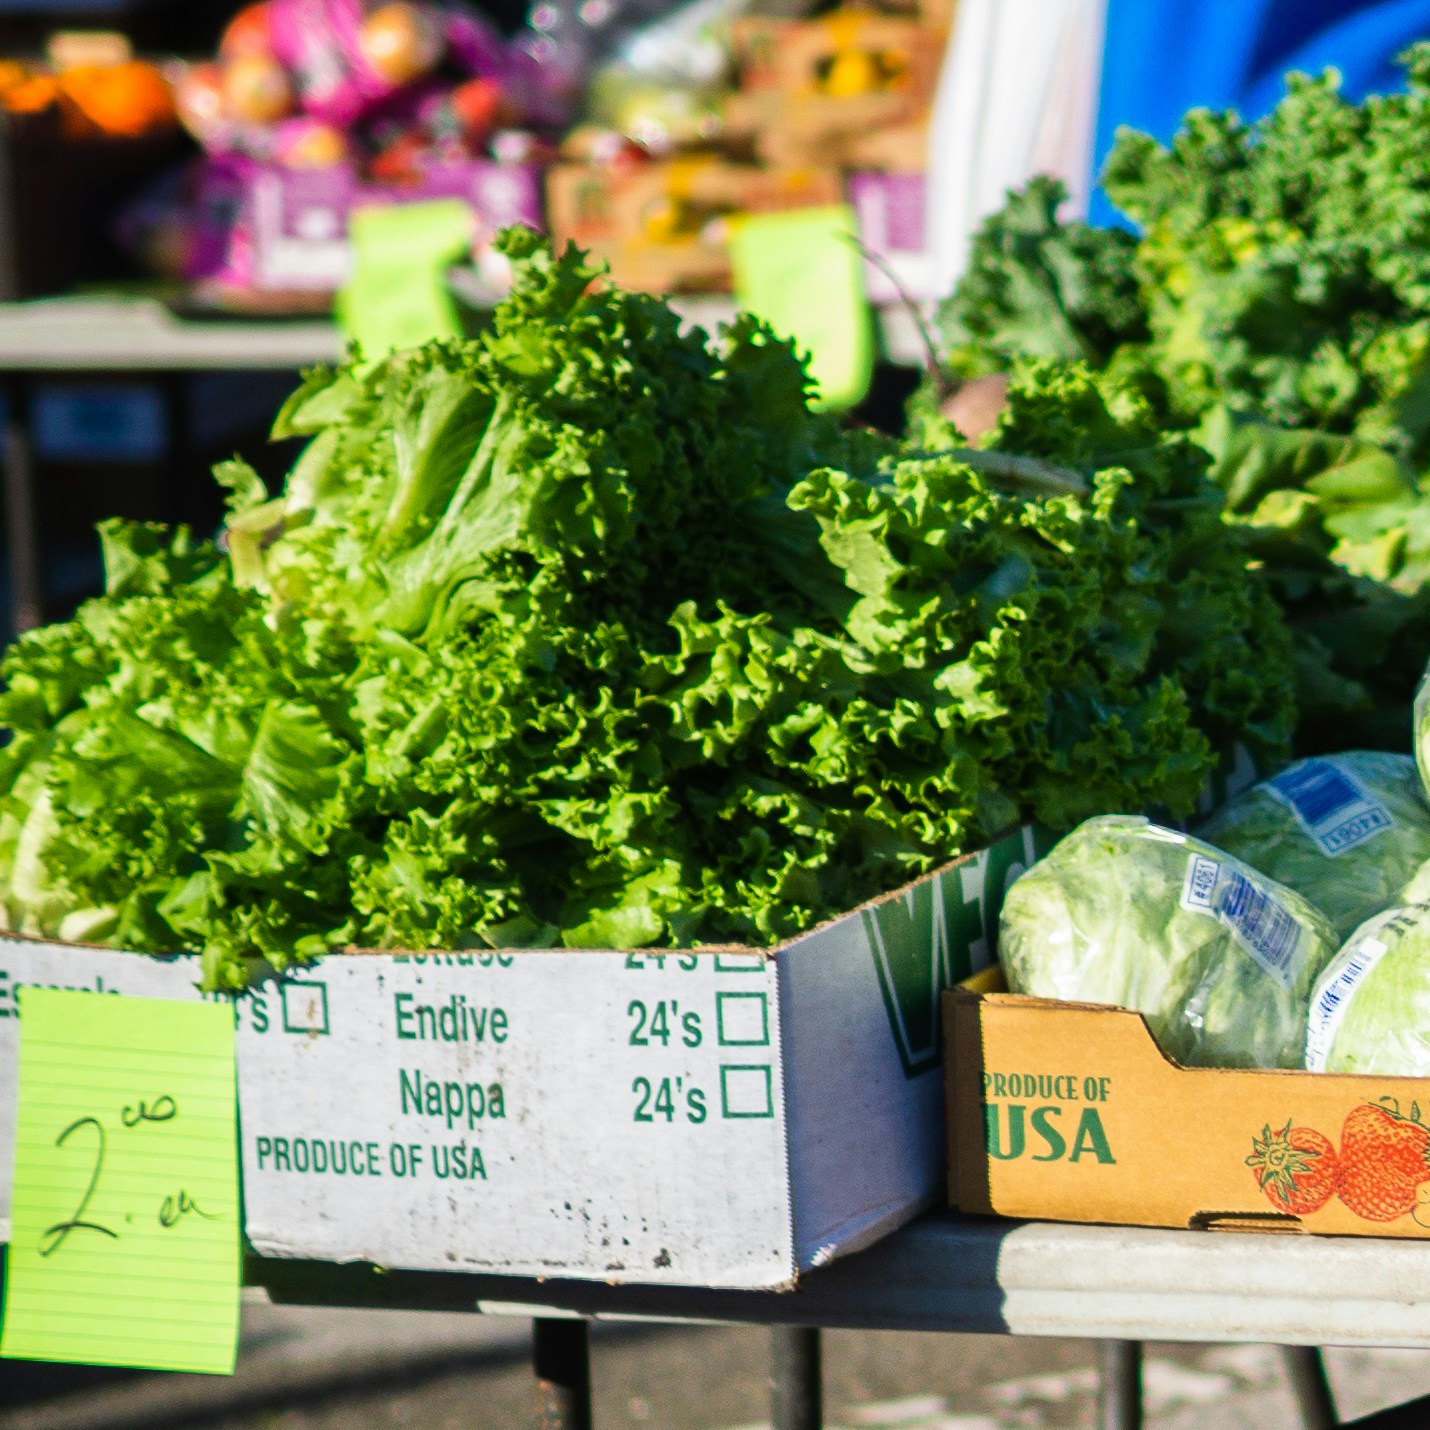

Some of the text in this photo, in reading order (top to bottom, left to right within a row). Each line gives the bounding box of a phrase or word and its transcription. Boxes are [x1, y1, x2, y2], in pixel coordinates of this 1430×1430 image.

[394, 993, 703, 1047] Endive 24's
[400, 1069, 708, 1129] Nappa 24's
[980, 1072, 1112, 1102] PRODUCE OF
[255, 1136, 488, 1181] PRODUCE OF USA
[980, 1102, 1117, 1165] USA
